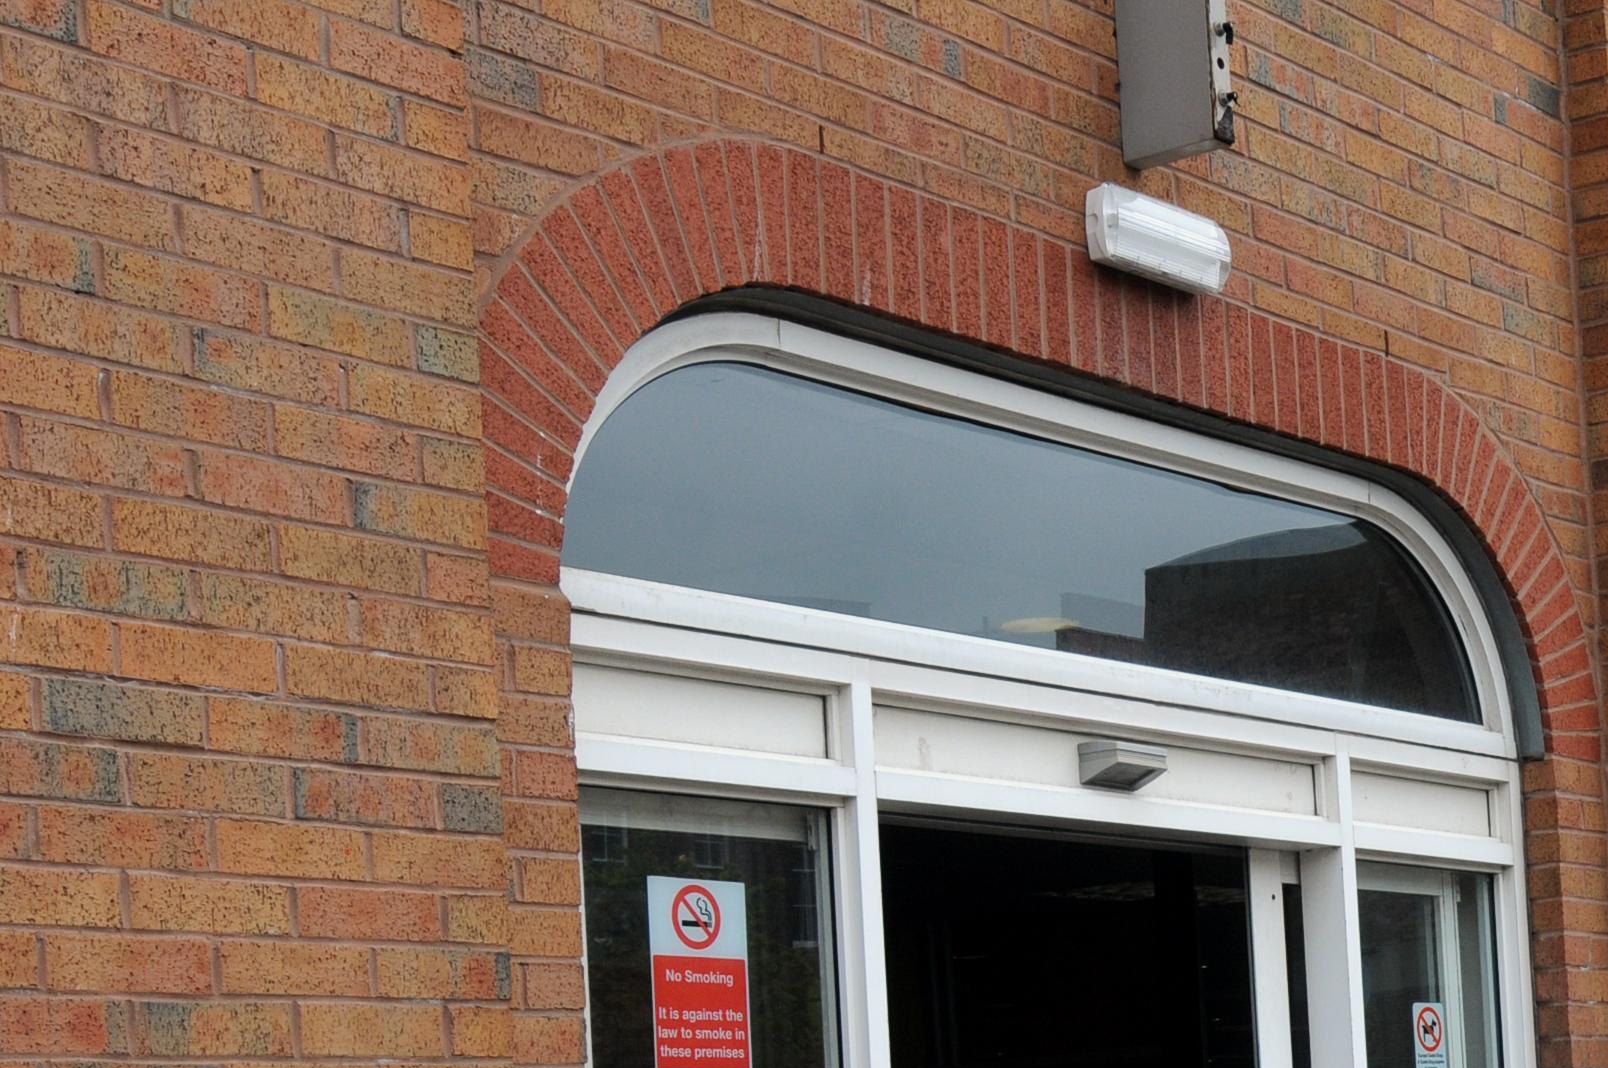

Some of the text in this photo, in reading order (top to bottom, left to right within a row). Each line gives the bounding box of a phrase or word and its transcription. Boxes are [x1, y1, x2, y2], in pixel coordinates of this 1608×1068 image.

[665, 968, 733, 987] No Smoking
[659, 1007, 743, 1024] It is against the
[658, 1025, 745, 1040] law to smoke in
[660, 1045, 745, 1060] these premises
